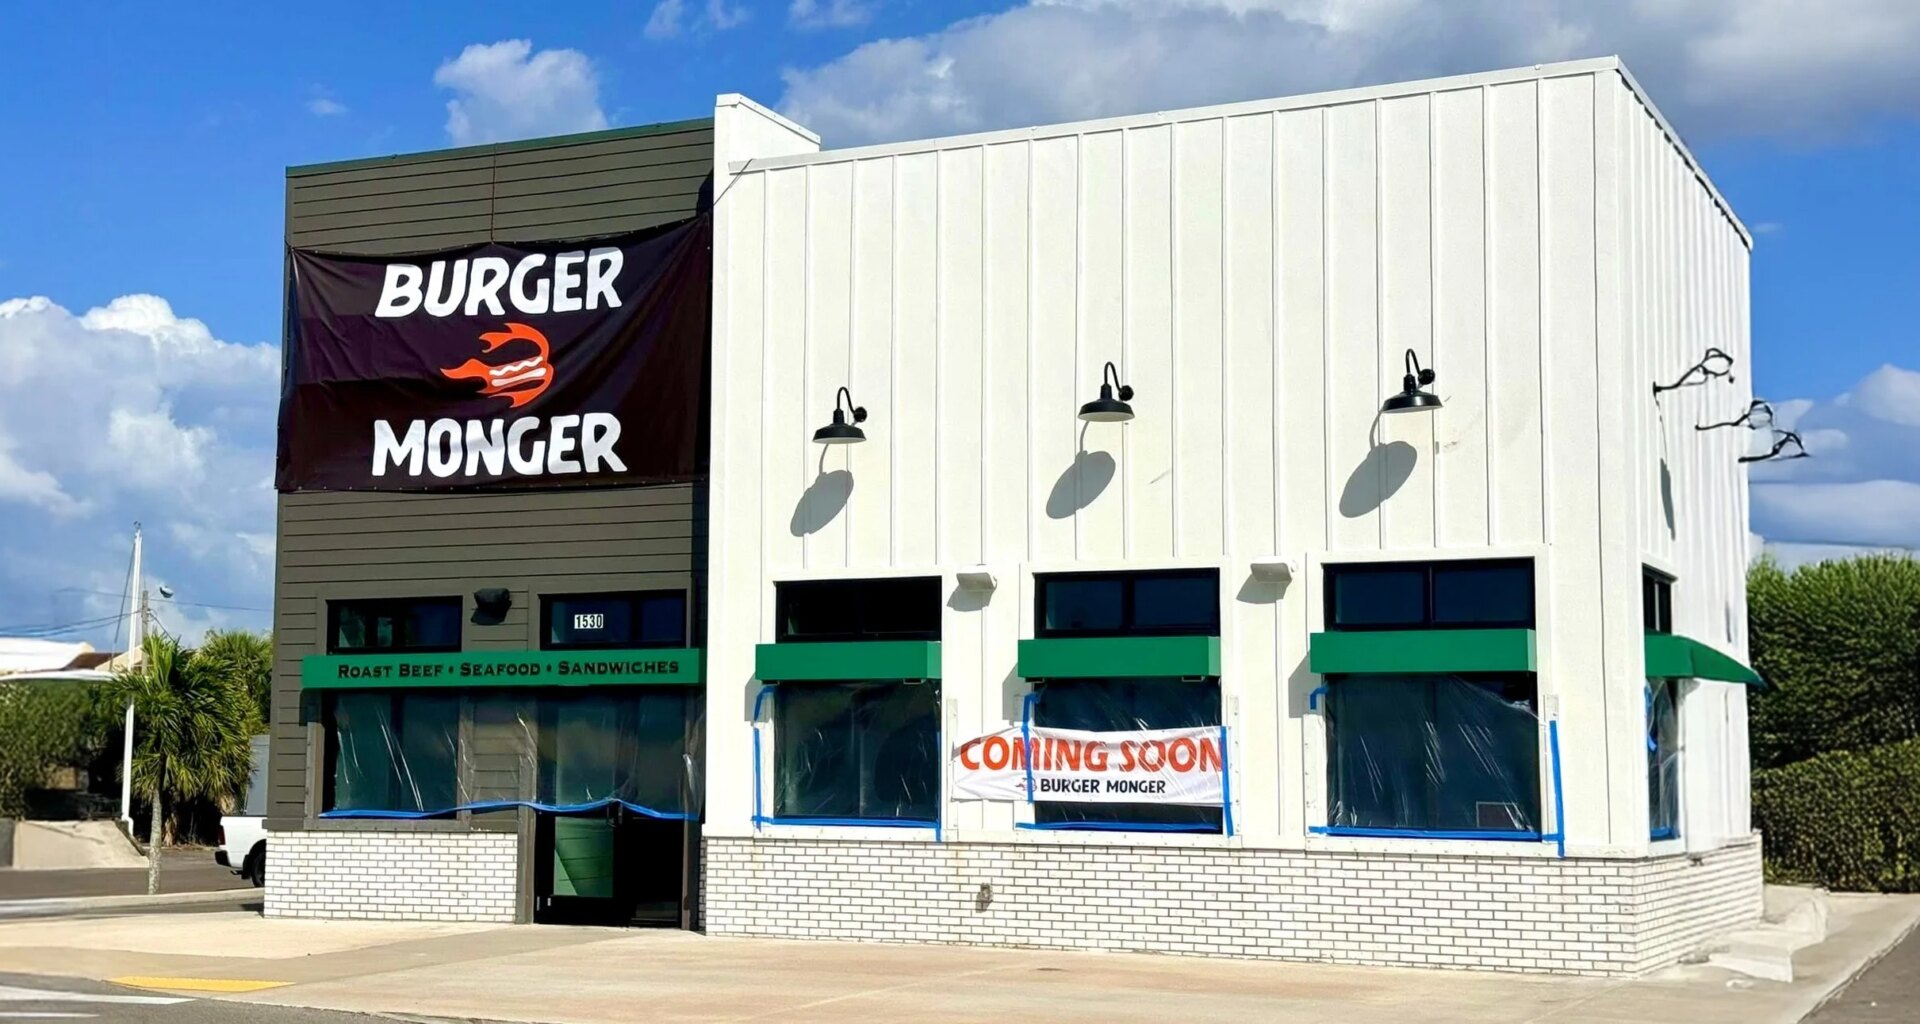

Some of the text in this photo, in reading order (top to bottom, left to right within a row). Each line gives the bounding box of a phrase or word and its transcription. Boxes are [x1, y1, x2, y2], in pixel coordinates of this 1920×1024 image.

[375, 246, 624, 318] BURGER
[372, 412, 627, 477] MONGER
[576, 614, 602, 628] 1530
[338, 661, 680, 678] ROAST BEEF SEAFOOD SANDWICHES
[960, 736, 1223, 772] COMING SOON
[1040, 778, 1166, 794] BURGER MONGER
